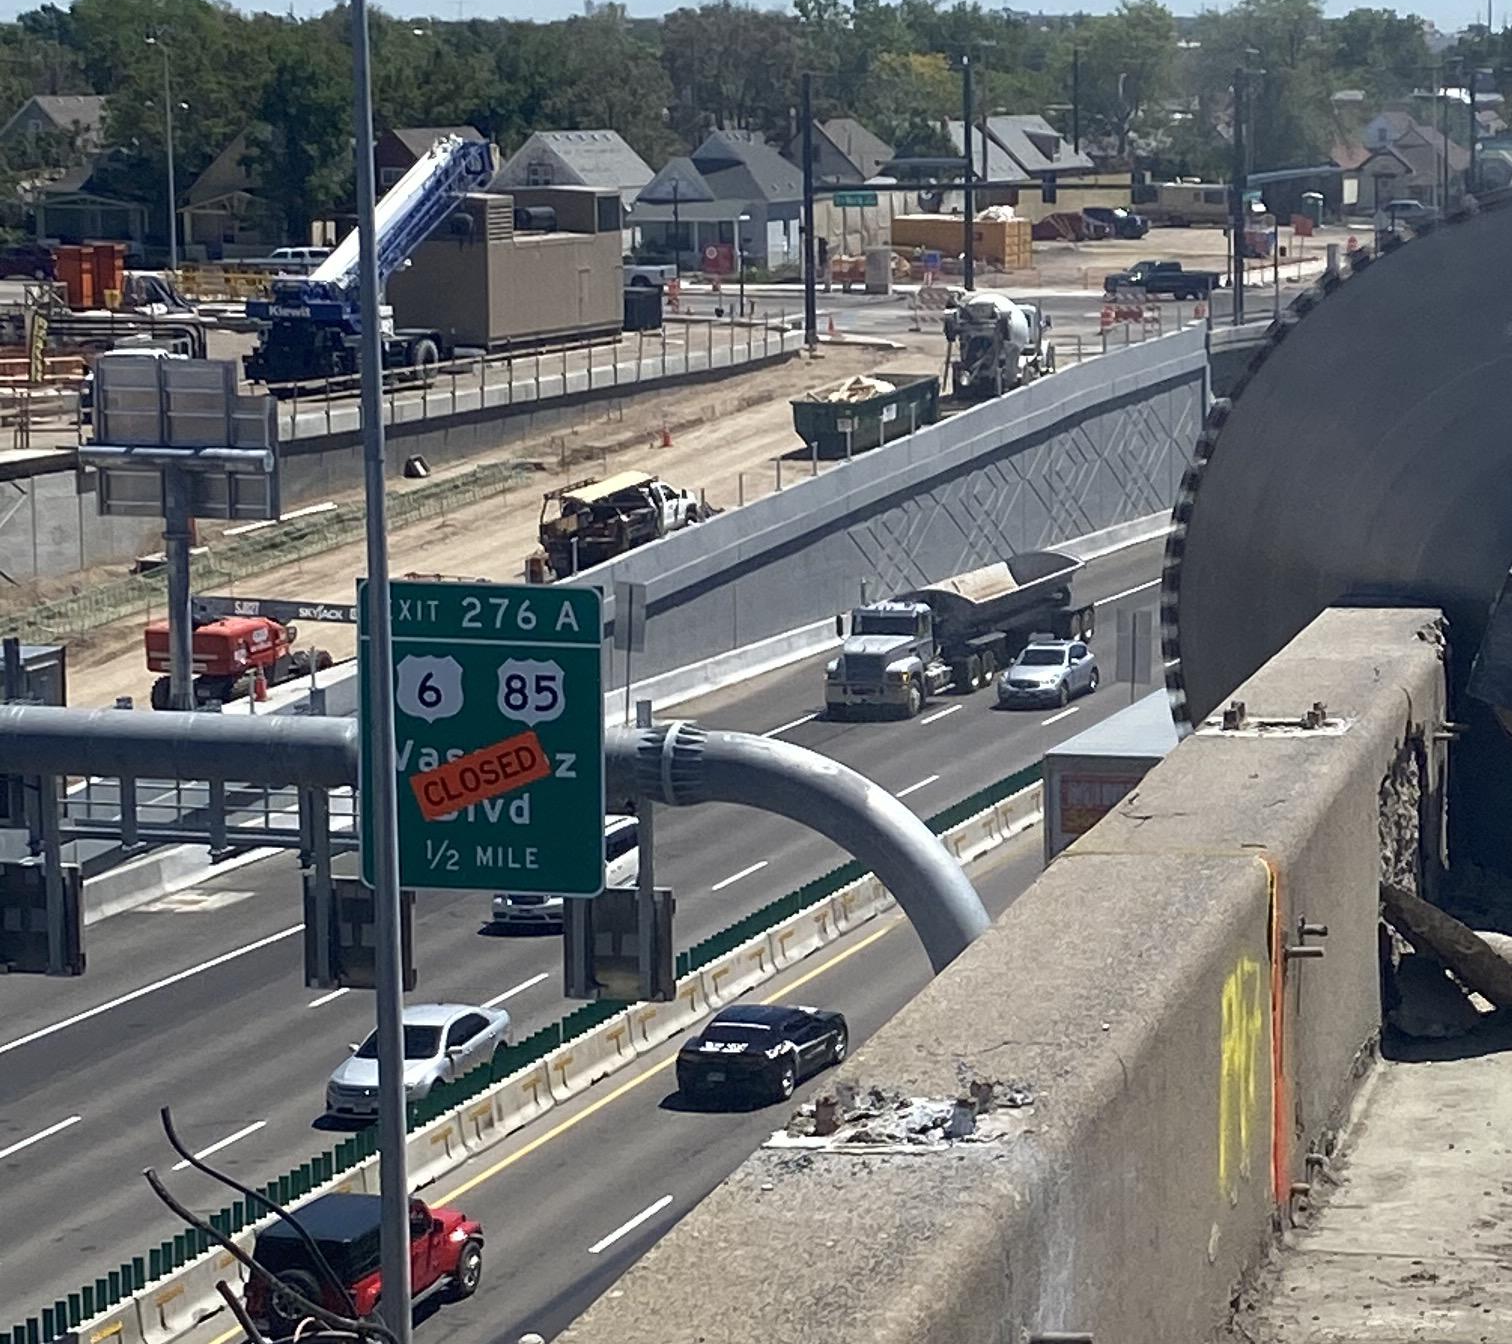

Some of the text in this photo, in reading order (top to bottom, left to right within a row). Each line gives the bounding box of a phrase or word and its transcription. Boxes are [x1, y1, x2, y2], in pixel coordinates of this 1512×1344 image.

[389, 599, 439, 623] XIT
[461, 596, 537, 631] 276
[555, 600, 580, 632] A
[417, 671, 443, 709] 6
[503, 672, 559, 713] 85
[394, 739, 577, 779] Vasz
[422, 745, 538, 807] CLOSED
[430, 792, 531, 825] lvd
[476, 845, 540, 869] MILE
